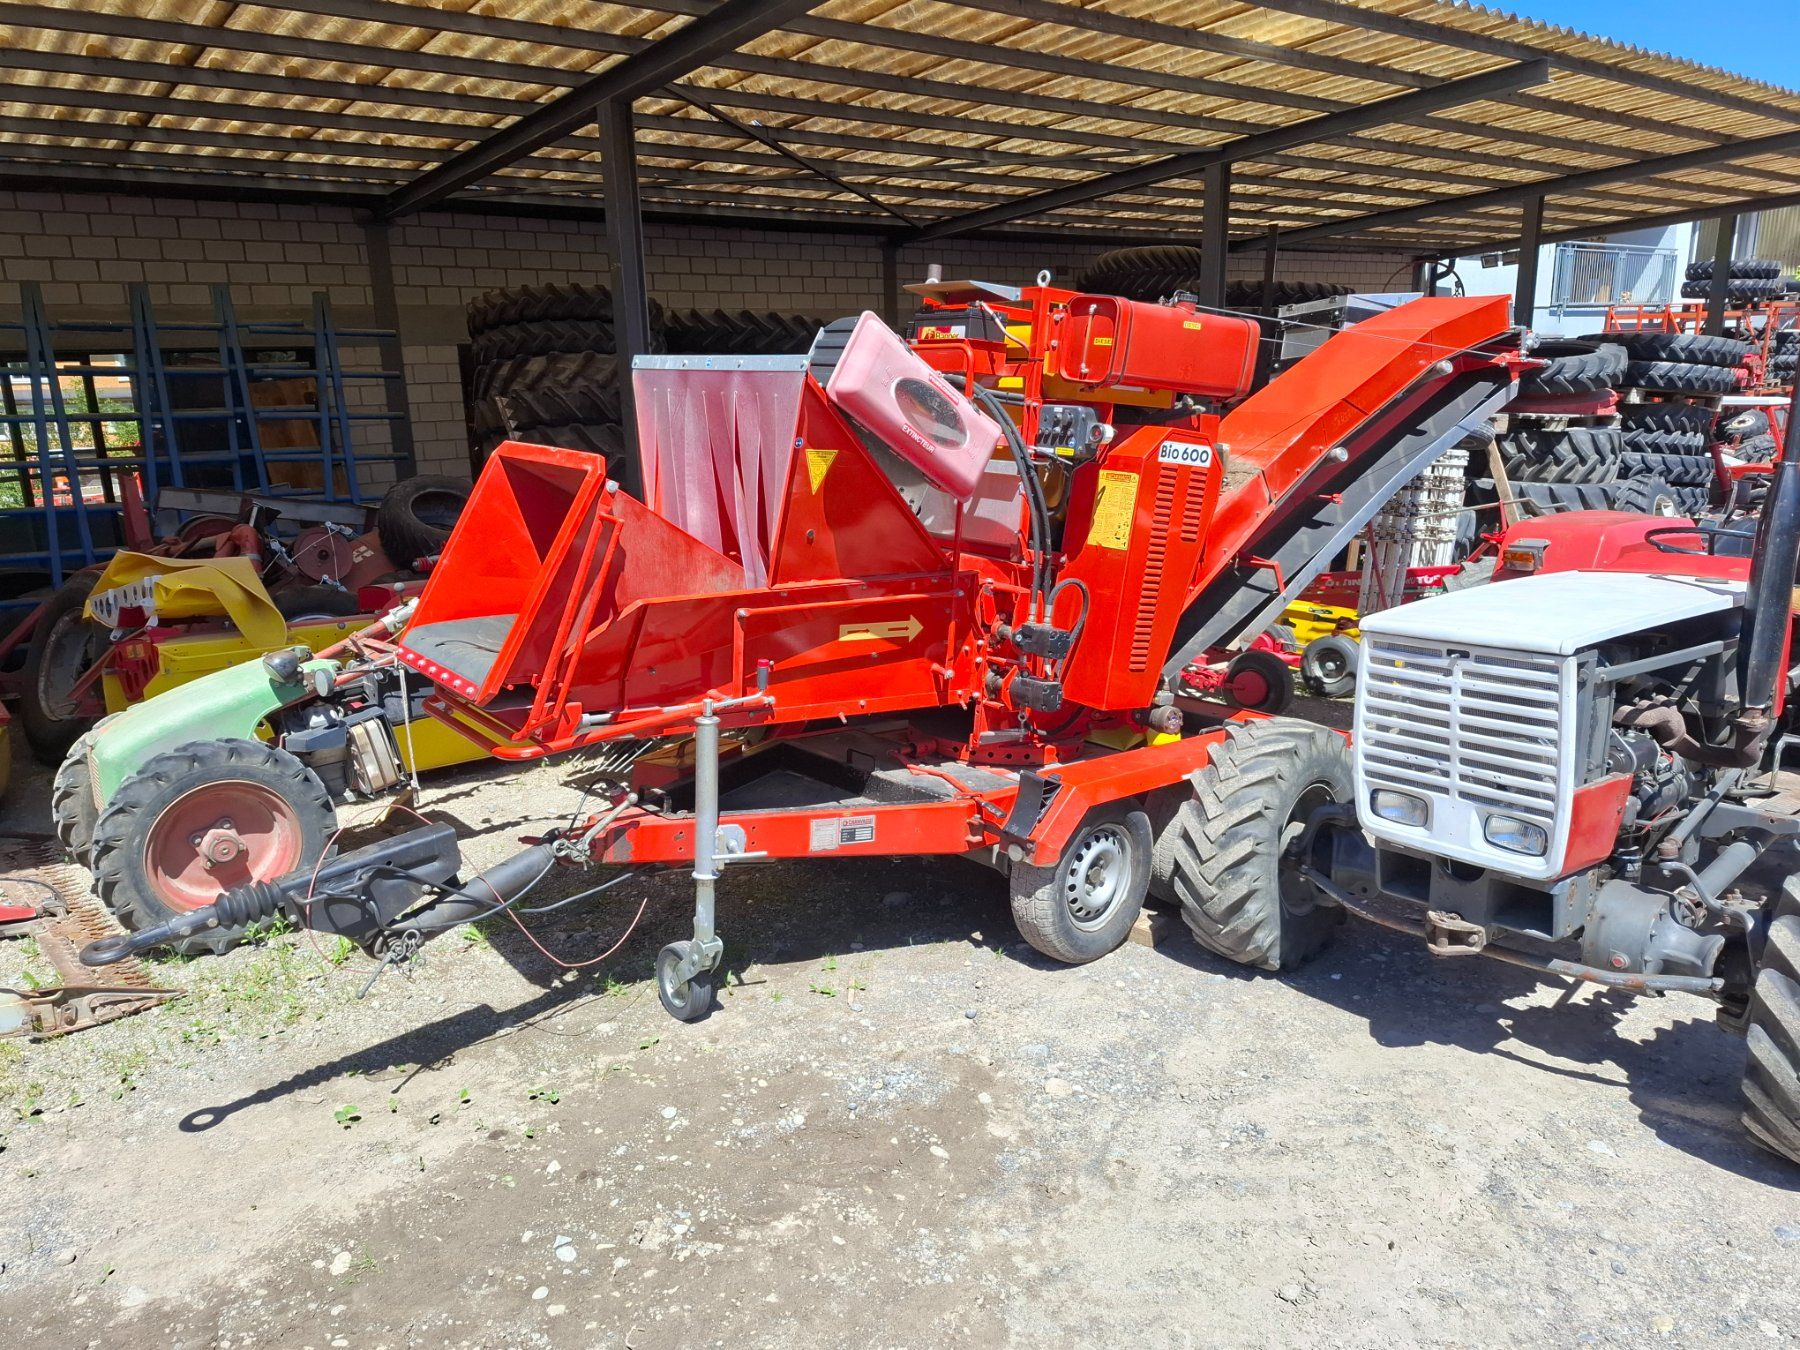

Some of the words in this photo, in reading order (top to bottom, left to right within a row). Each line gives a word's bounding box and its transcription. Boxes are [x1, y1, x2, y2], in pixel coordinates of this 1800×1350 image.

[902, 424, 935, 453] EXTINCTEUR
[1160, 444, 1180, 459] Bio
[1181, 447, 1209, 463] 600
